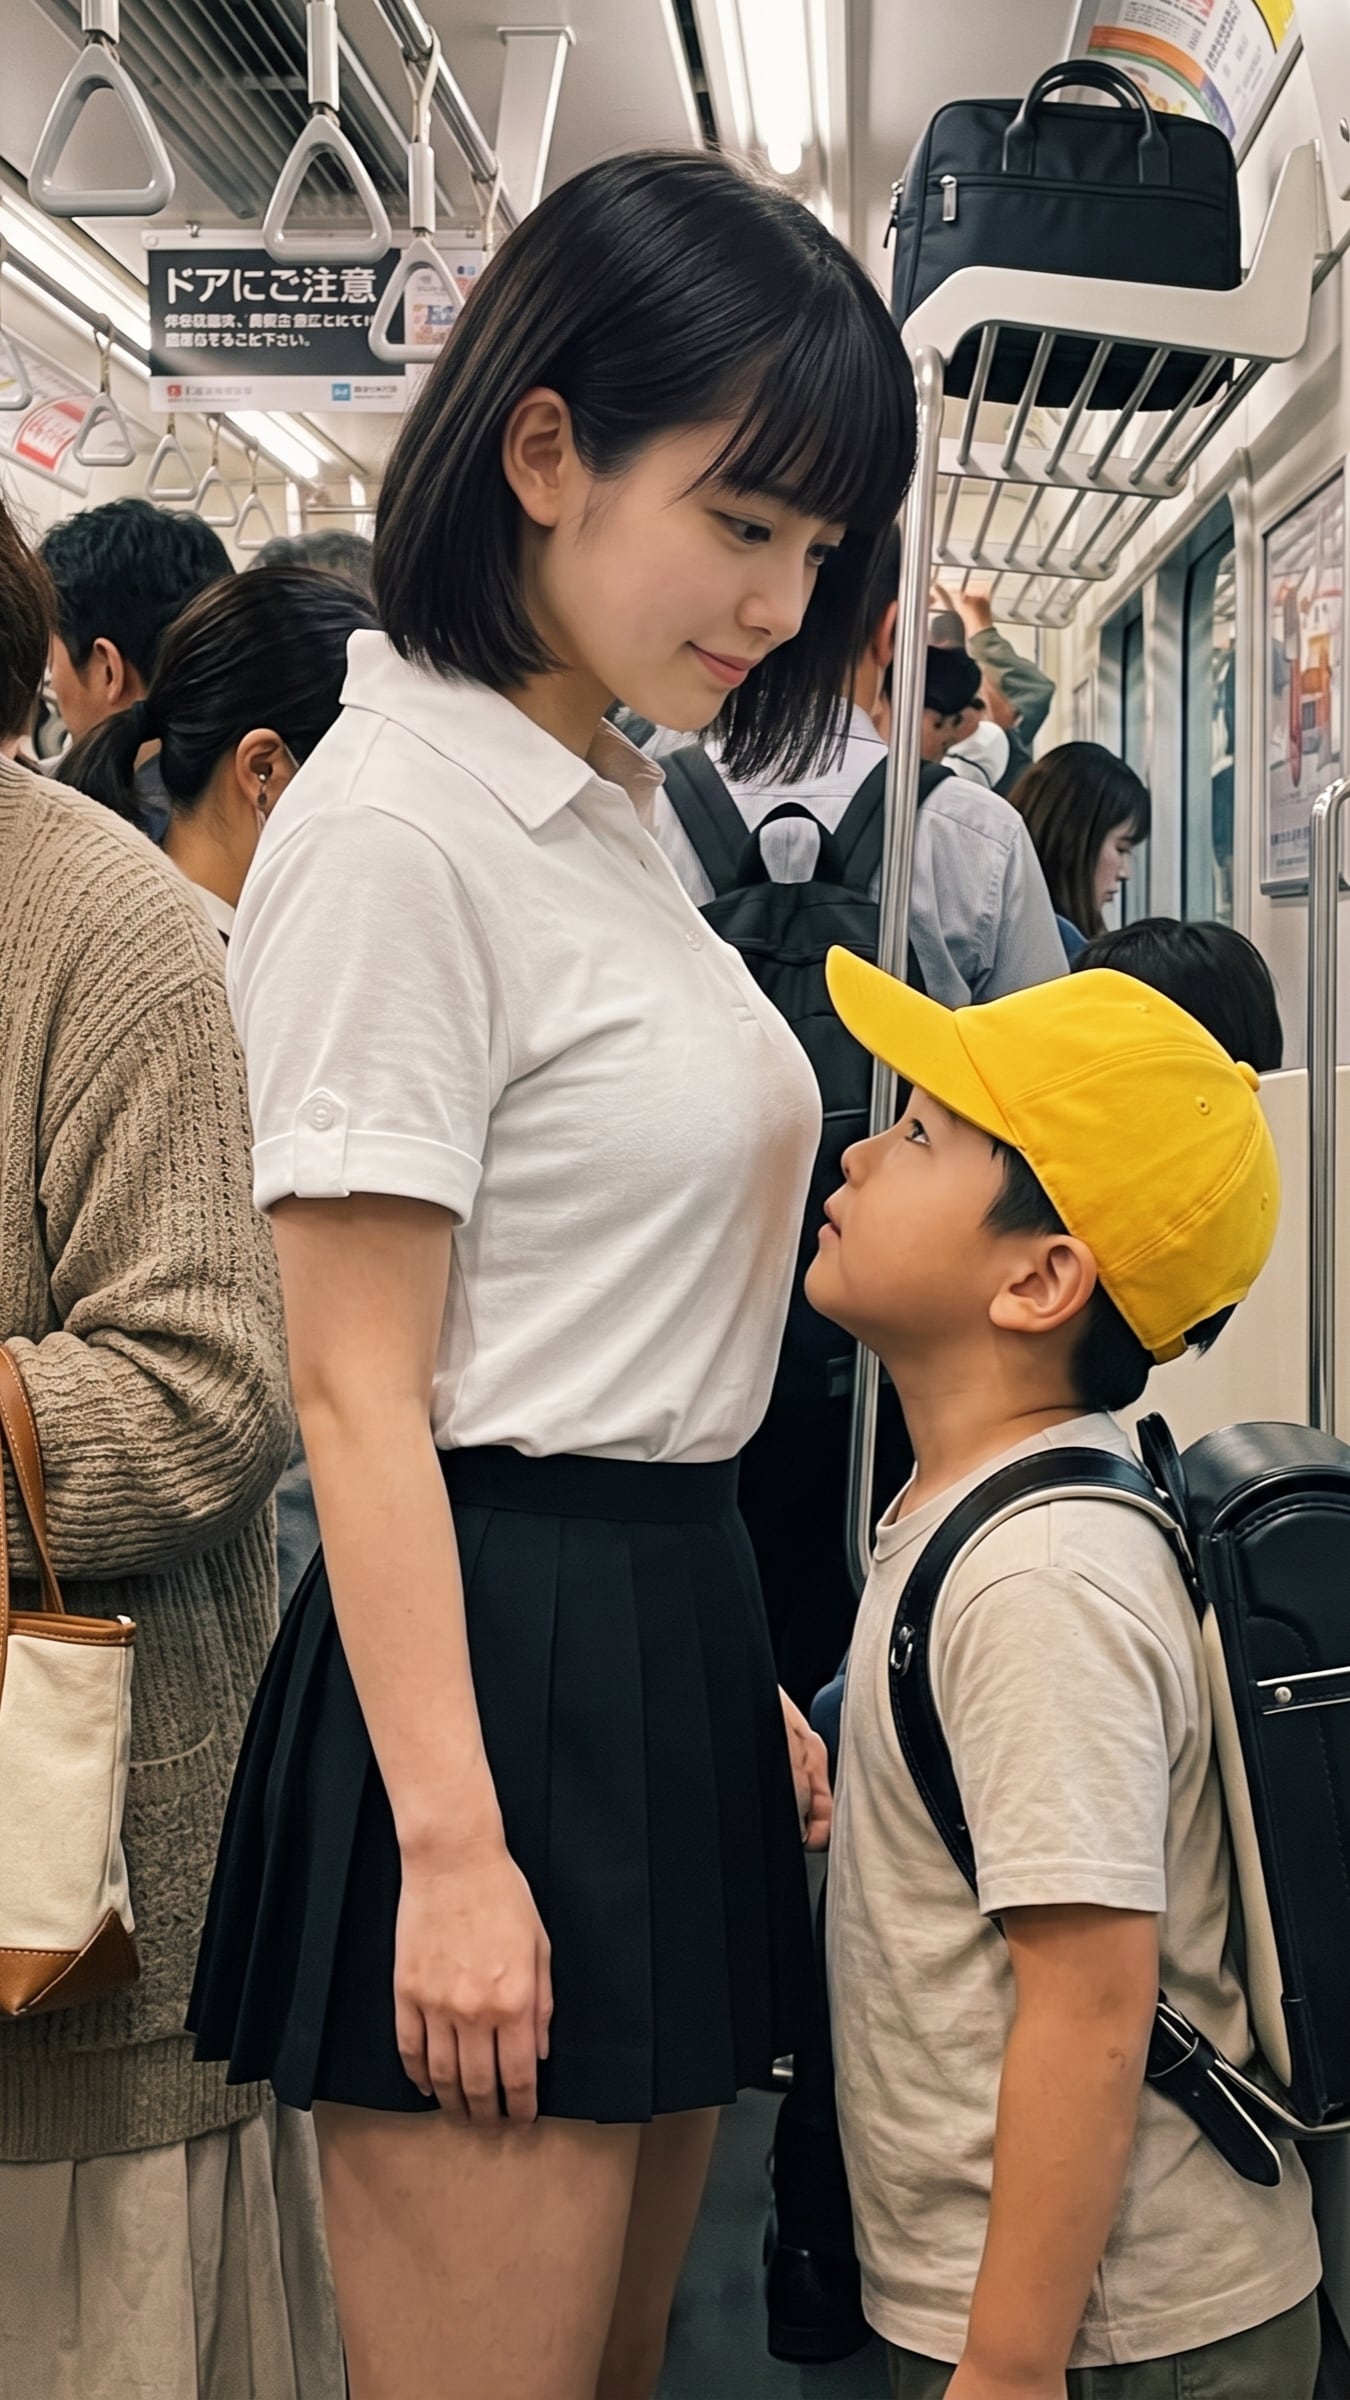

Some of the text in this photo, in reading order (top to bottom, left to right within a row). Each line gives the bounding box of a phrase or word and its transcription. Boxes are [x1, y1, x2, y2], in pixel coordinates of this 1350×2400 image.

[167, 267, 377, 304] ドアにご注意
